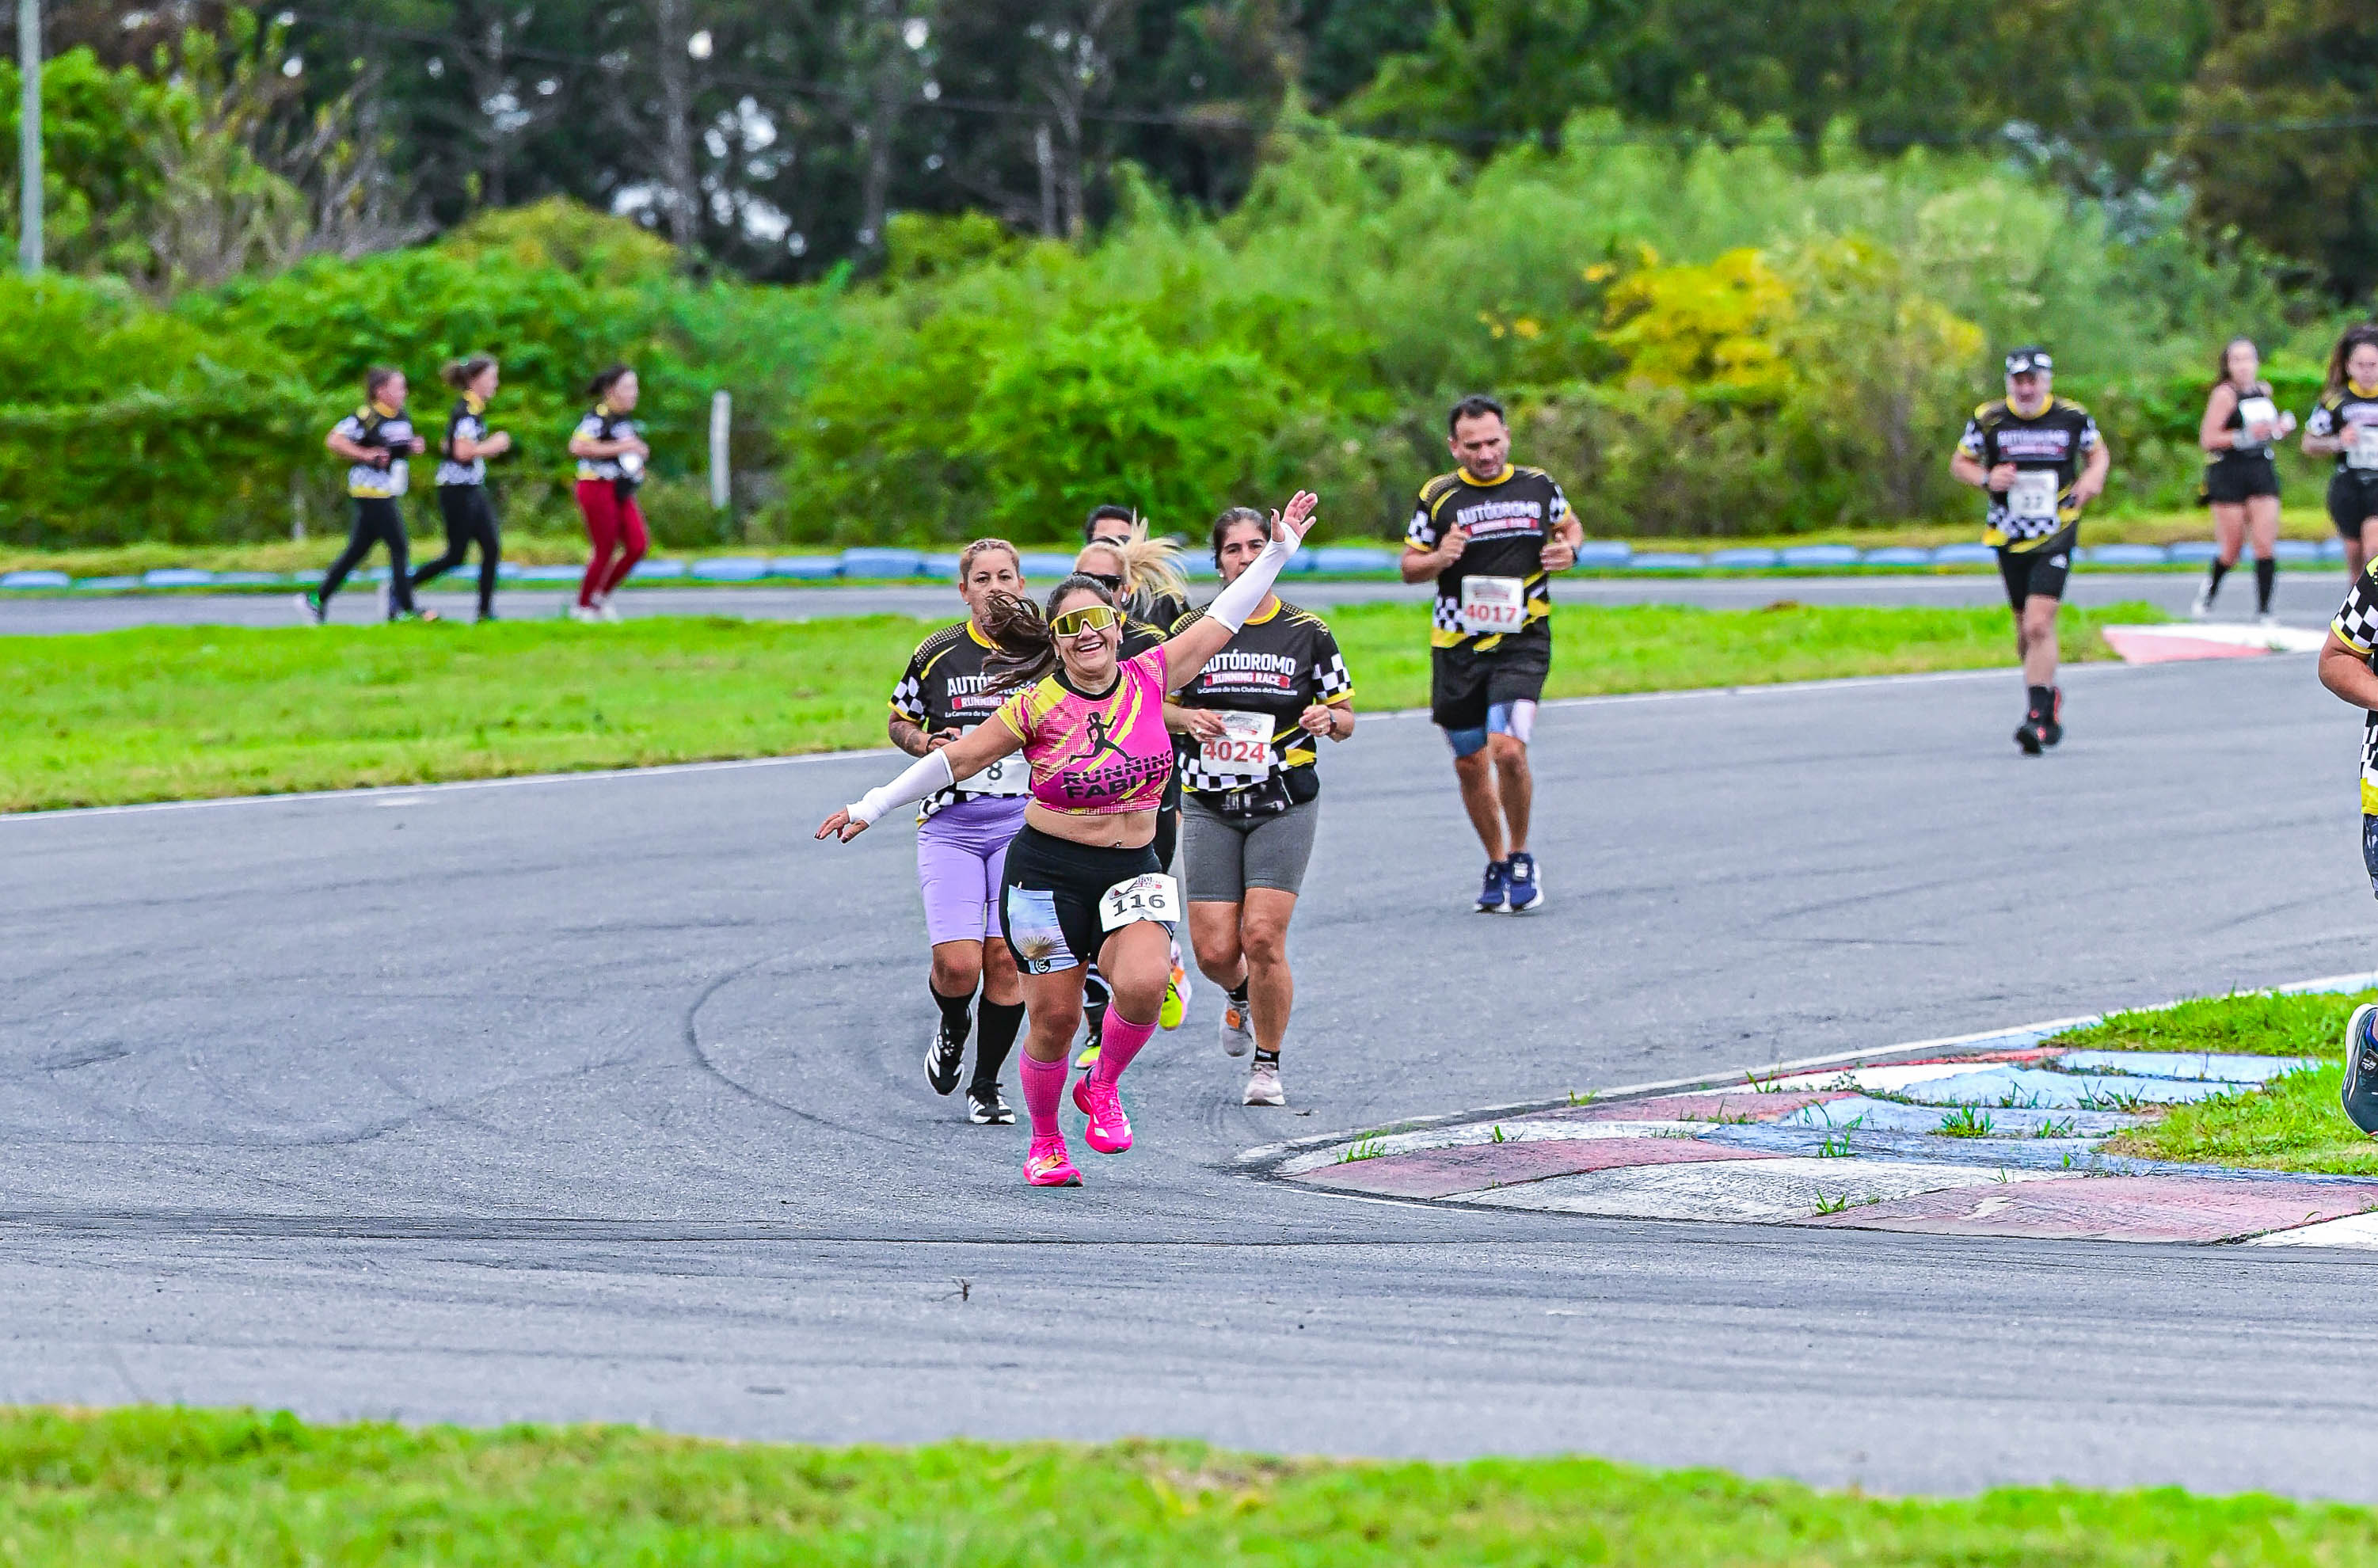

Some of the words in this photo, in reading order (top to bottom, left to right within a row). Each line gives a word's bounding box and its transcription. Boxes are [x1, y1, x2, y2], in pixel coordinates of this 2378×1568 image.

[1465, 604, 1516, 623] 4017
[1199, 648, 1297, 676] AUTÓDROMO
[1212, 672, 1253, 685] RUNNING
[1255, 672, 1280, 687] RACE
[961, 696, 1002, 708] RUNNING
[1203, 739, 1265, 763] 4024
[1063, 749, 1172, 784] RUNNING
[1113, 894, 1166, 917] 116
